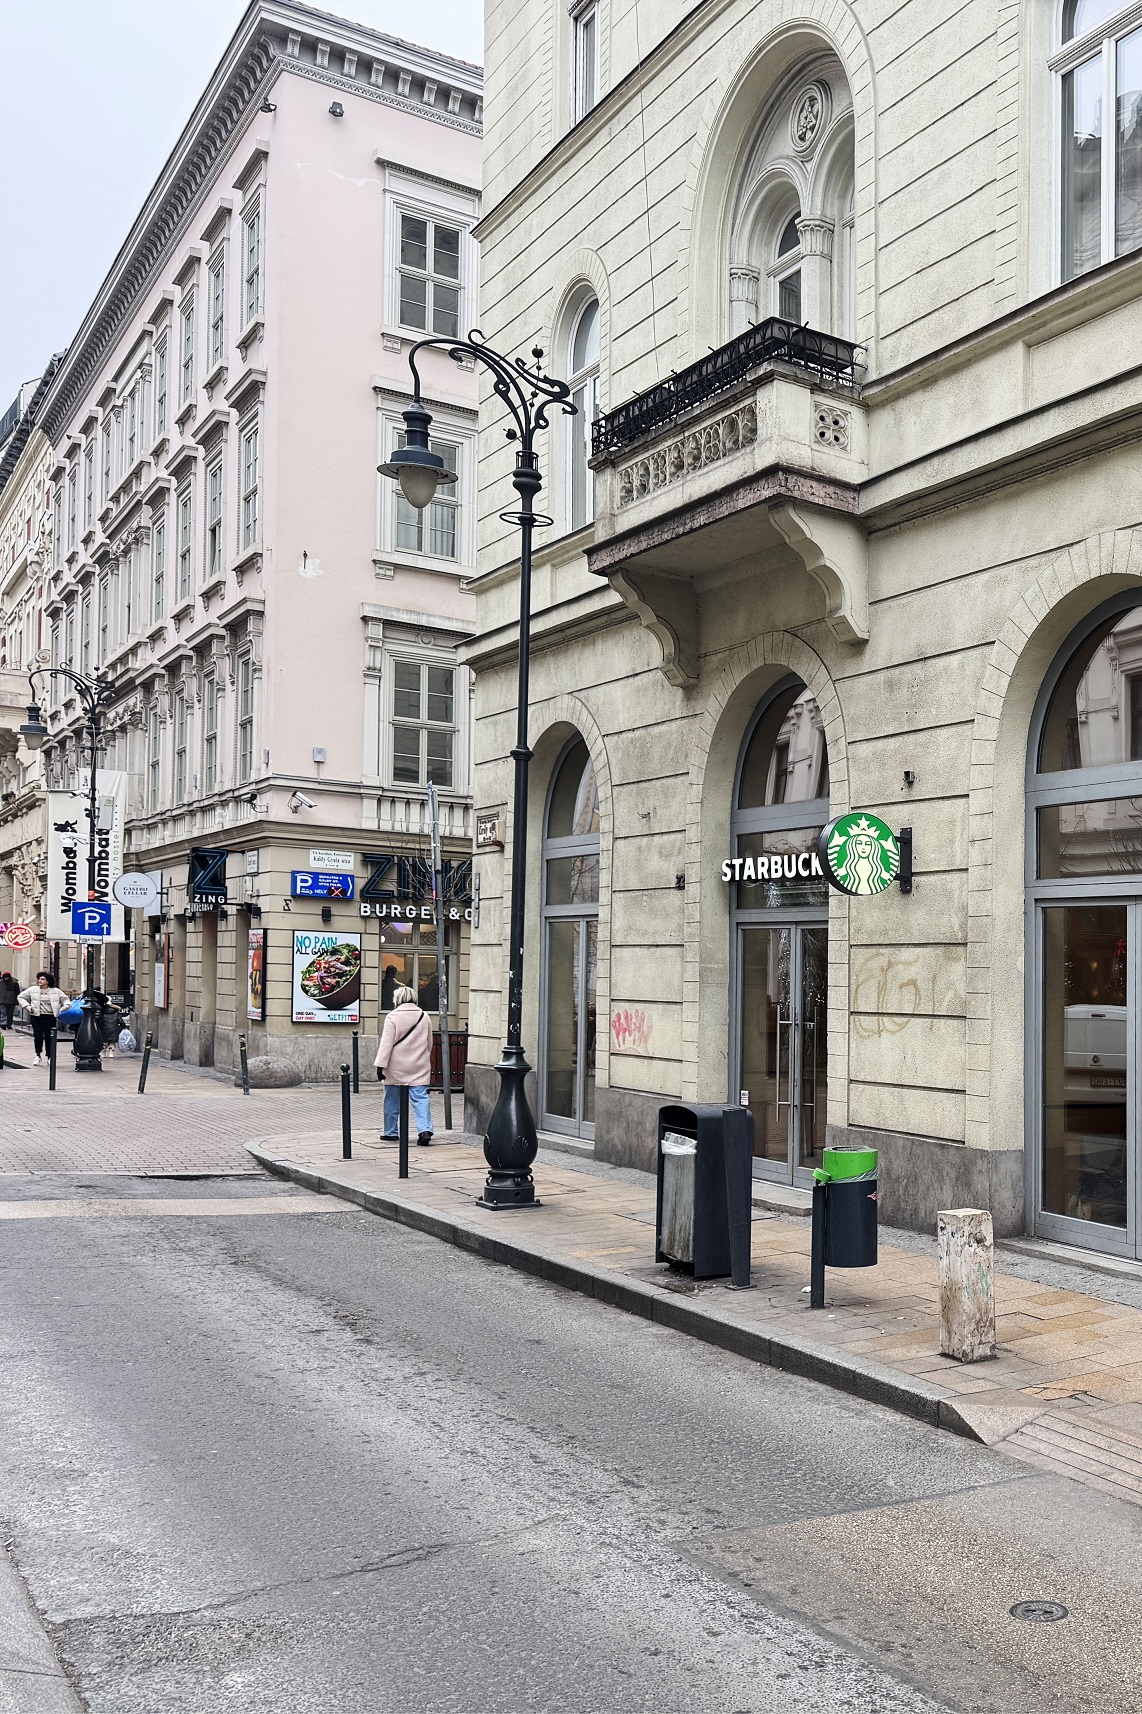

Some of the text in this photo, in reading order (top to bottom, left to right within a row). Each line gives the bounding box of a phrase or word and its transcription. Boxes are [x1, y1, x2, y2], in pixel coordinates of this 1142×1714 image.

[296, 876, 312, 894] P
[194, 894, 226, 904] ZING
[360, 903, 431, 919] BURGE
[84, 912, 101, 931] P
[295, 935, 338, 949] NO PAIN
